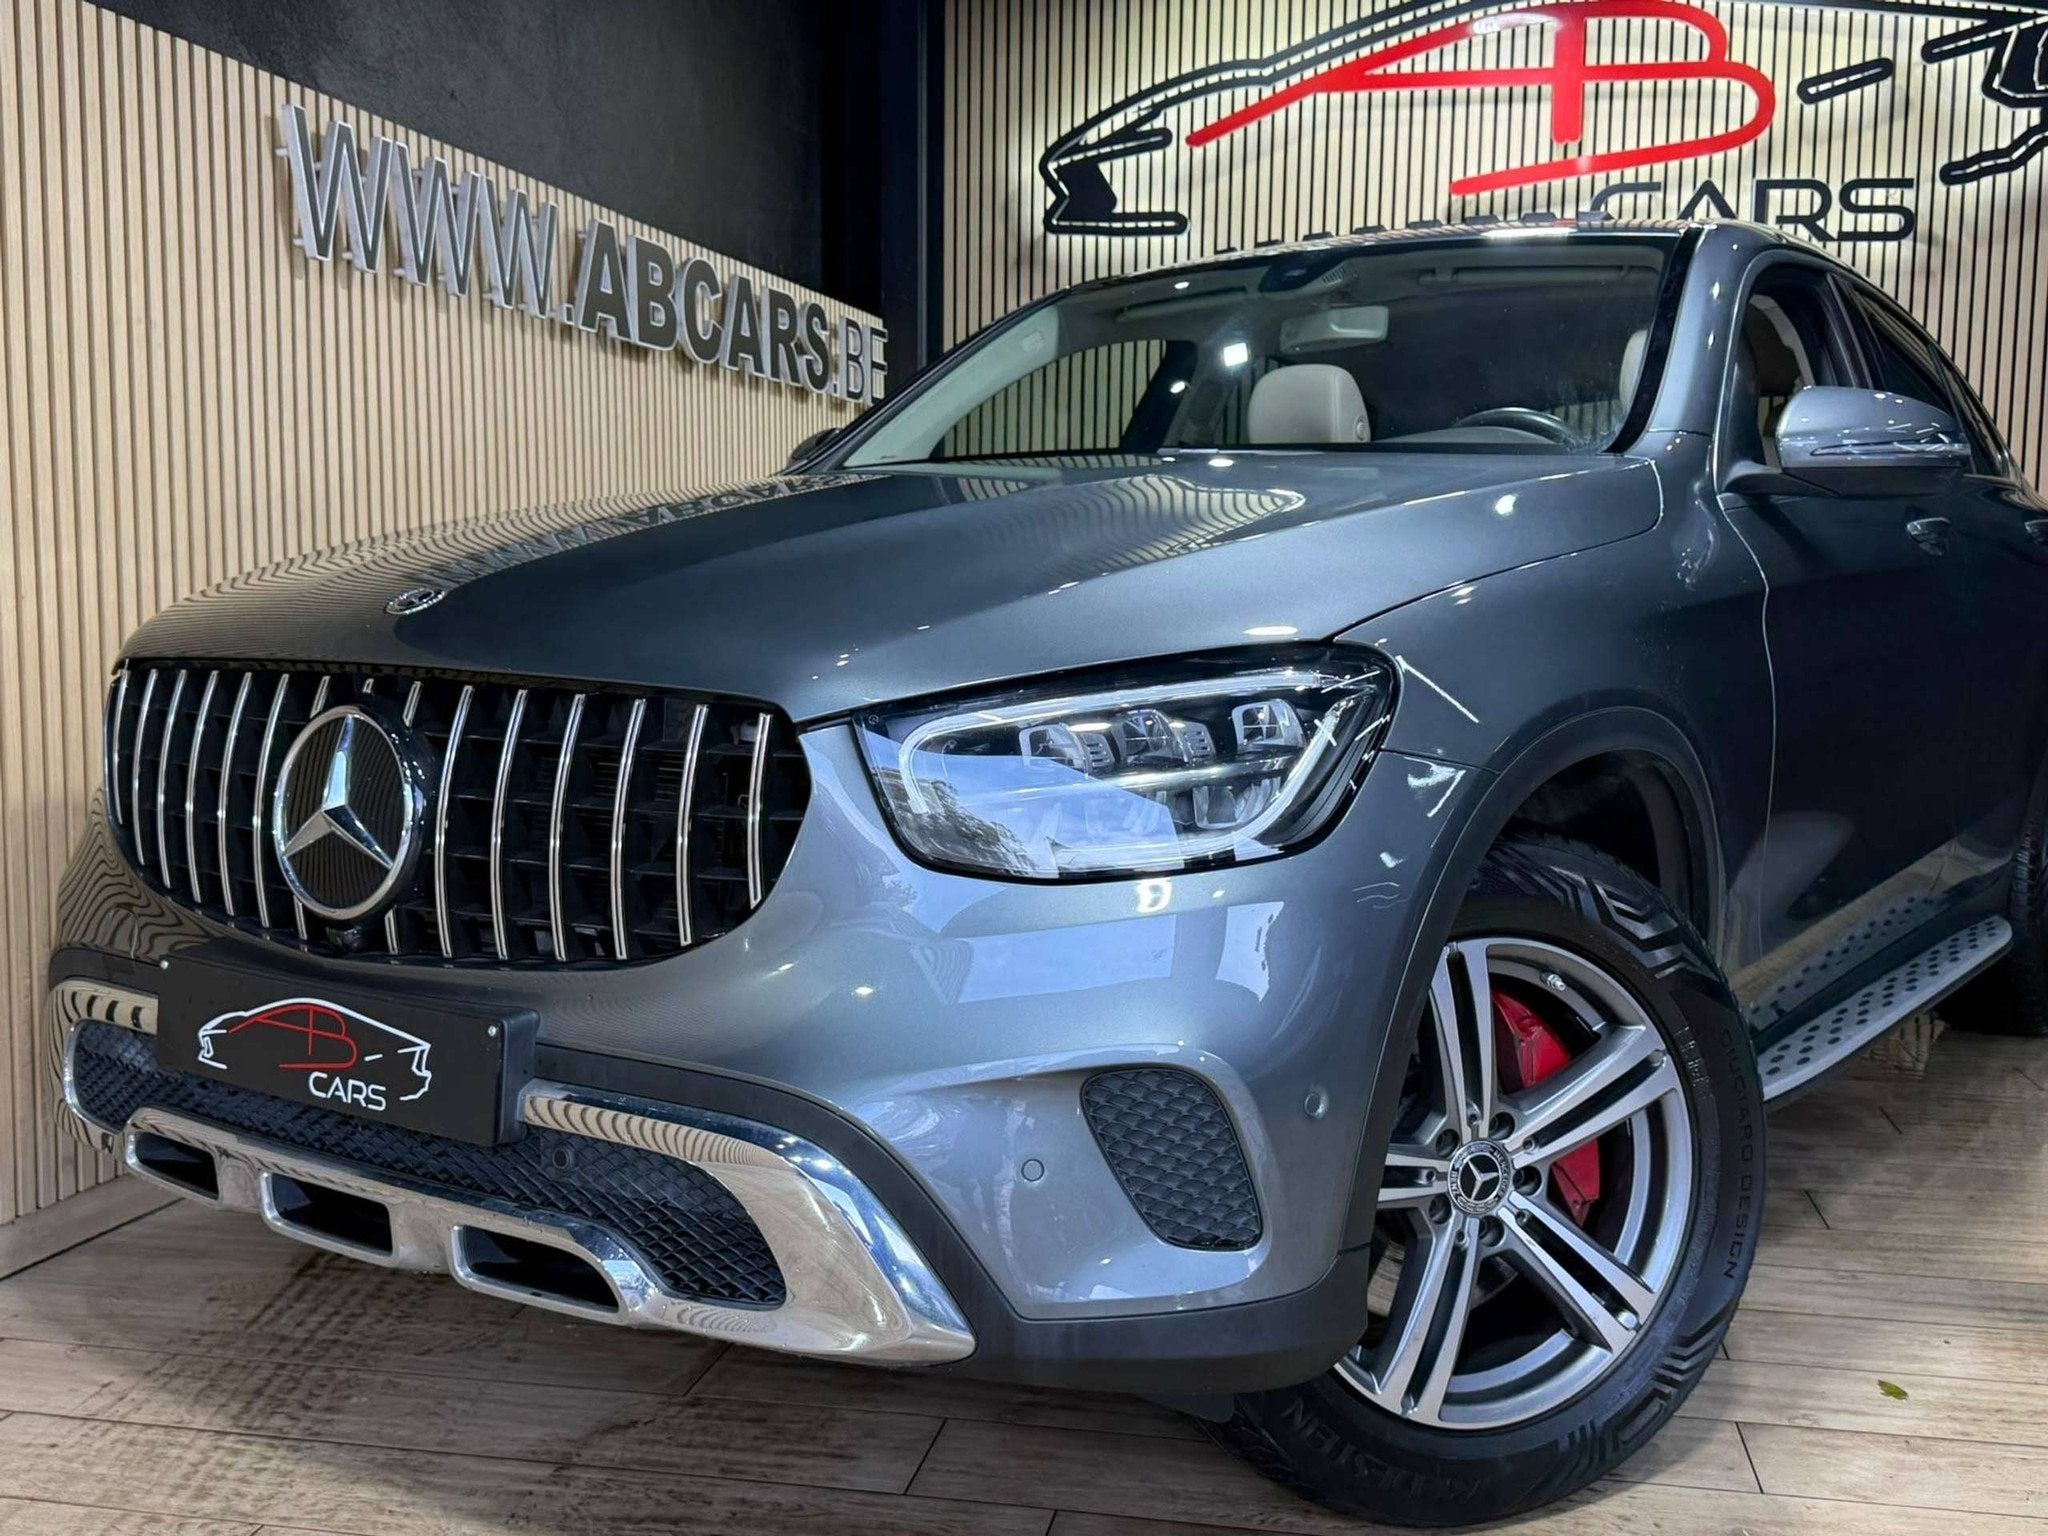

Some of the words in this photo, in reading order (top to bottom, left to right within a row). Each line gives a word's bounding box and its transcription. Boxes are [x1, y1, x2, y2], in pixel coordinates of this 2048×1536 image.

[283, 103, 888, 404] WWW.ABCARS.BE
[308, 1070, 387, 1111] CARS
[1722, 1174, 1753, 1279] DESIGN
